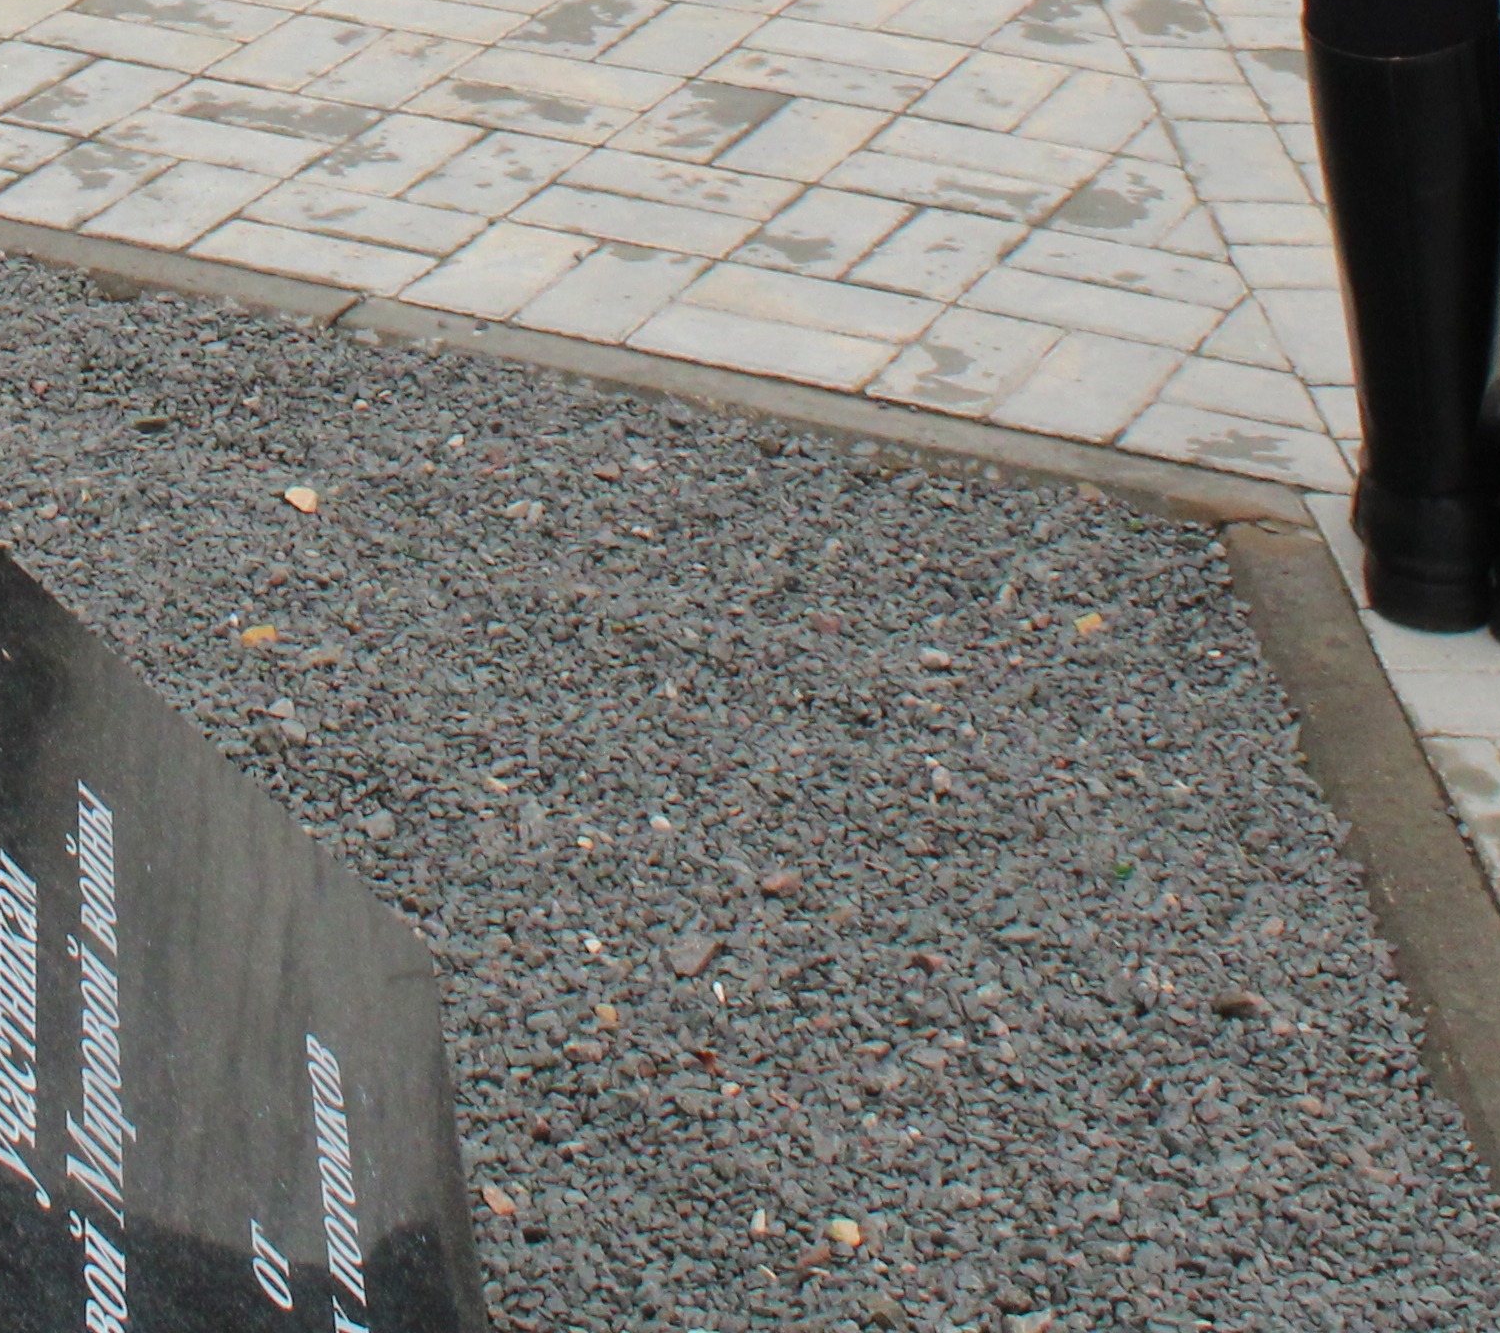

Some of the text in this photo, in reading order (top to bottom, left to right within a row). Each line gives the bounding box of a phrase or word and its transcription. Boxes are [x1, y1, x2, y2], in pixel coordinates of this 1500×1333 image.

[64, 779, 118, 958] войны
[65, 933, 138, 1230] Мировой
[305, 1033, 368, 1308] потомков
[249, 1217, 294, 1311] от
